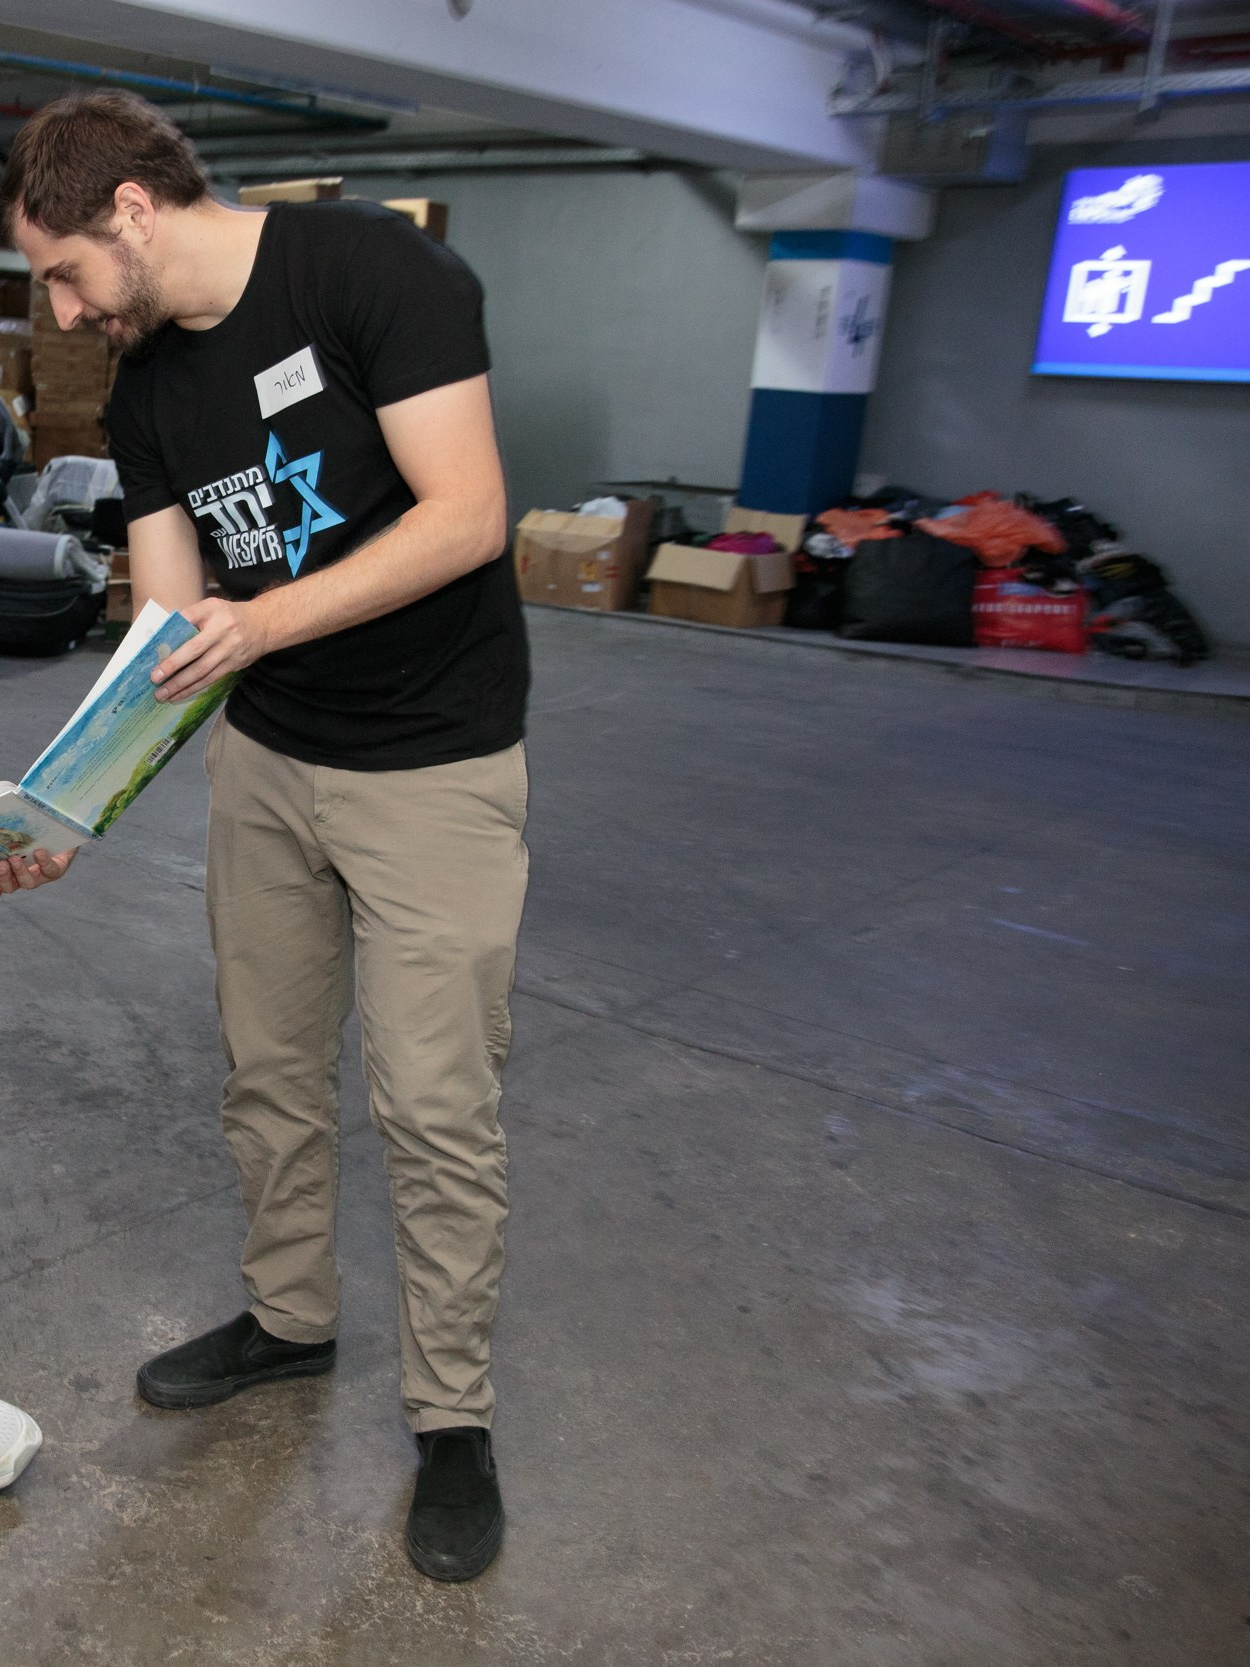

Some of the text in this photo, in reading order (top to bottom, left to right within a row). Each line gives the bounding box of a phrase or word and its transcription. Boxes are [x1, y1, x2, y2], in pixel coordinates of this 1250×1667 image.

[274, 364, 306, 396] מאור
[187, 466, 264, 509] מתנדבים
[193, 482, 273, 536] יחד
[209, 527, 228, 539] עם
[216, 525, 283, 570] WESPER
